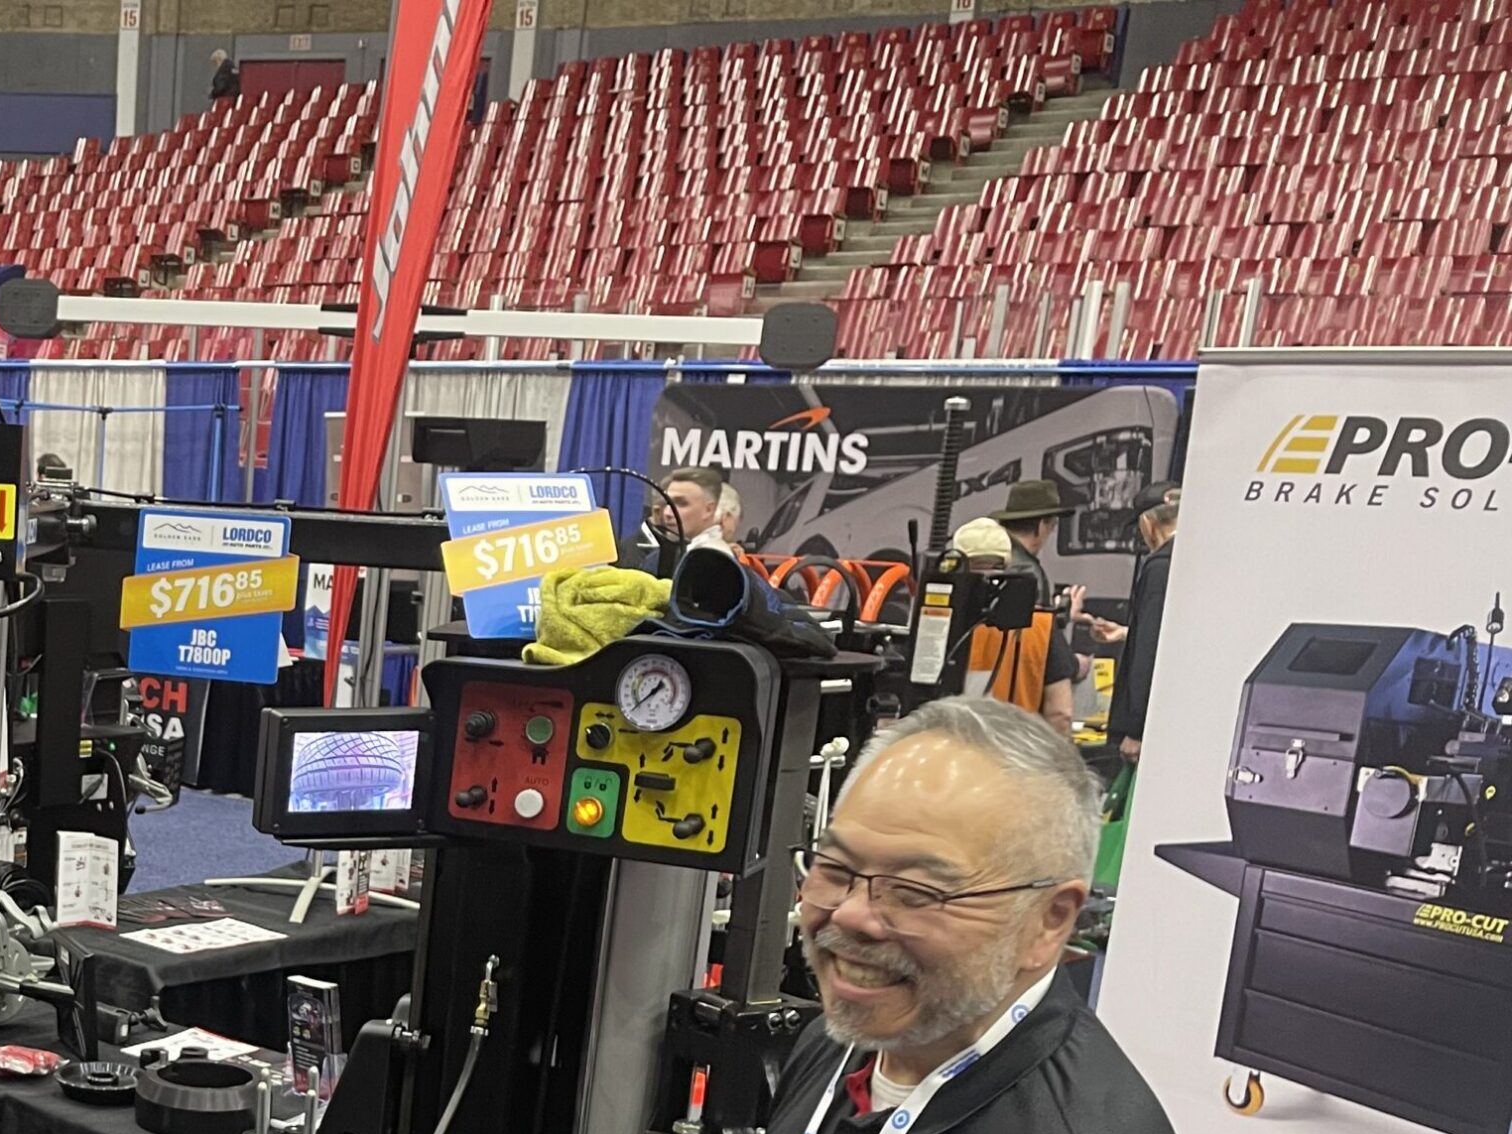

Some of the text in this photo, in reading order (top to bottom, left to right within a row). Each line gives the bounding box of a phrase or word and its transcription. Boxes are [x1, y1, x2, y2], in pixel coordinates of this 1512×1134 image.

[123, 10, 137, 26] 15
[520, 8, 533, 26] 15
[661, 427, 869, 474] MARTINS
[529, 485, 578, 499] LORDCO
[1244, 481, 1500, 512] BRAKE SOL
[222, 527, 272, 543] LORDCO
[462, 518, 510, 535] LEASE FROM
[146, 558, 195, 572] LEASE FROM
[191, 629, 217, 647] JBC
[178, 645, 231, 666] T7800P
[139, 676, 188, 713] CH
[523, 776, 550, 787] AUTO
